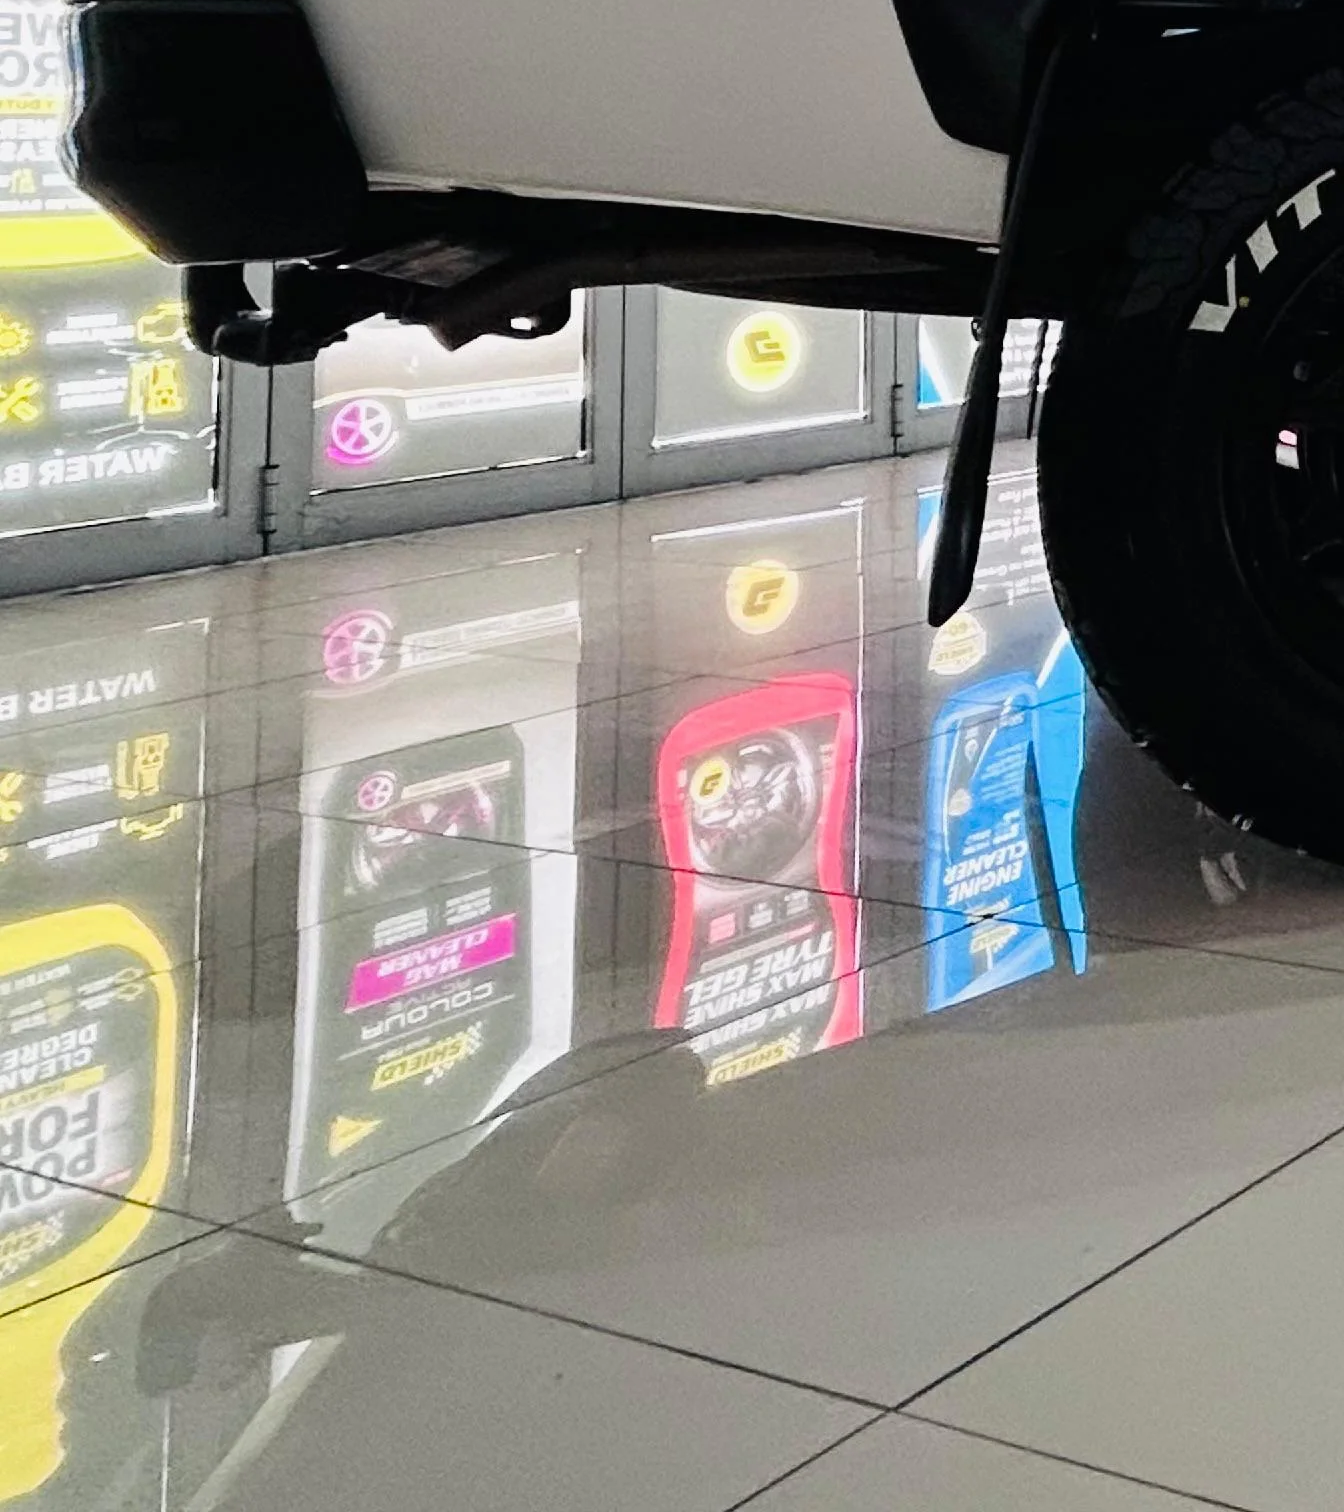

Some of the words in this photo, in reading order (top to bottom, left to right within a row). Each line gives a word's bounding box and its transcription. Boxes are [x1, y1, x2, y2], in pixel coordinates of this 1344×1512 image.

[28, 669, 157, 714] WATER
[943, 840, 1028, 886] CLEANER
[946, 860, 1023, 906] ENGINE
[376, 928, 489, 978] CLEANER
[750, 931, 833, 980] TYRE
[682, 982, 764, 1029] SHINE
[683, 964, 749, 1007] GEL
[361, 981, 494, 1040] COLOUR
